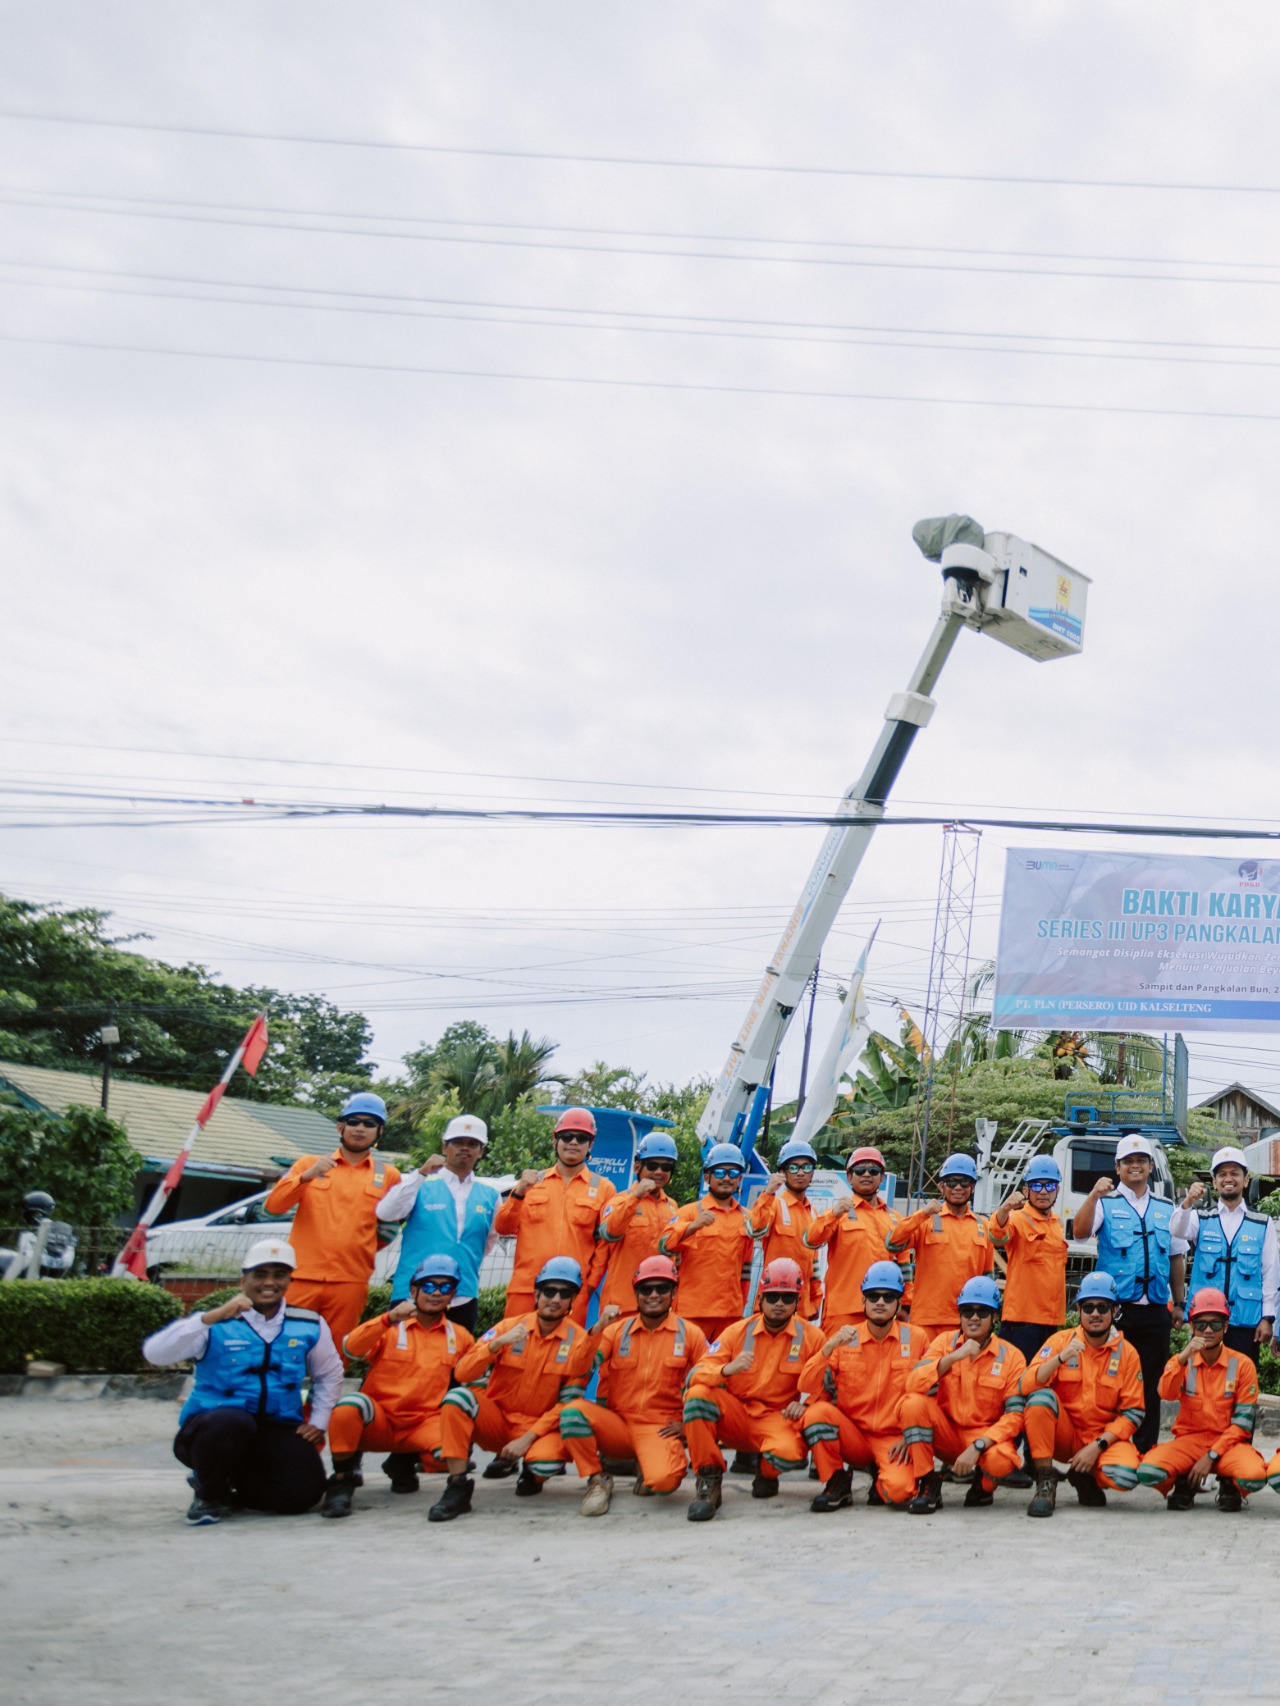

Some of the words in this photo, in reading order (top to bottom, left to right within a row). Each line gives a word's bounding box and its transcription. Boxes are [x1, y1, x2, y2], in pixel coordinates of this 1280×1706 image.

[1122, 888, 1199, 917] BAKTI
[1036, 919, 1102, 940] SERIES
[1108, 921, 1126, 940] III
[1131, 922, 1168, 941] UP3
[1113, 948, 1154, 960] Disiplin
[1156, 949, 1206, 961] Eksekusi
[1207, 950, 1261, 963] Wujudkan
[1158, 962, 1200, 974] Menuju
[1202, 963, 1256, 975] Penjualan
[1139, 982, 1174, 992] Sampit
[1175, 983, 1194, 991] dan
[1196, 984, 1248, 994] Pangkalan
[1250, 985, 1272, 995] Bun,
[1015, 999, 1031, 1009] PT.
[1034, 1000, 1056, 1009] PLN
[1058, 1000, 1114, 1011] (PERSERO)
[1117, 1001, 1137, 1011] UID
[1140, 1002, 1213, 1013] KALSELTENG
[741, 1008, 759, 1042] LINE
[605, 1166, 626, 1174] PLN
